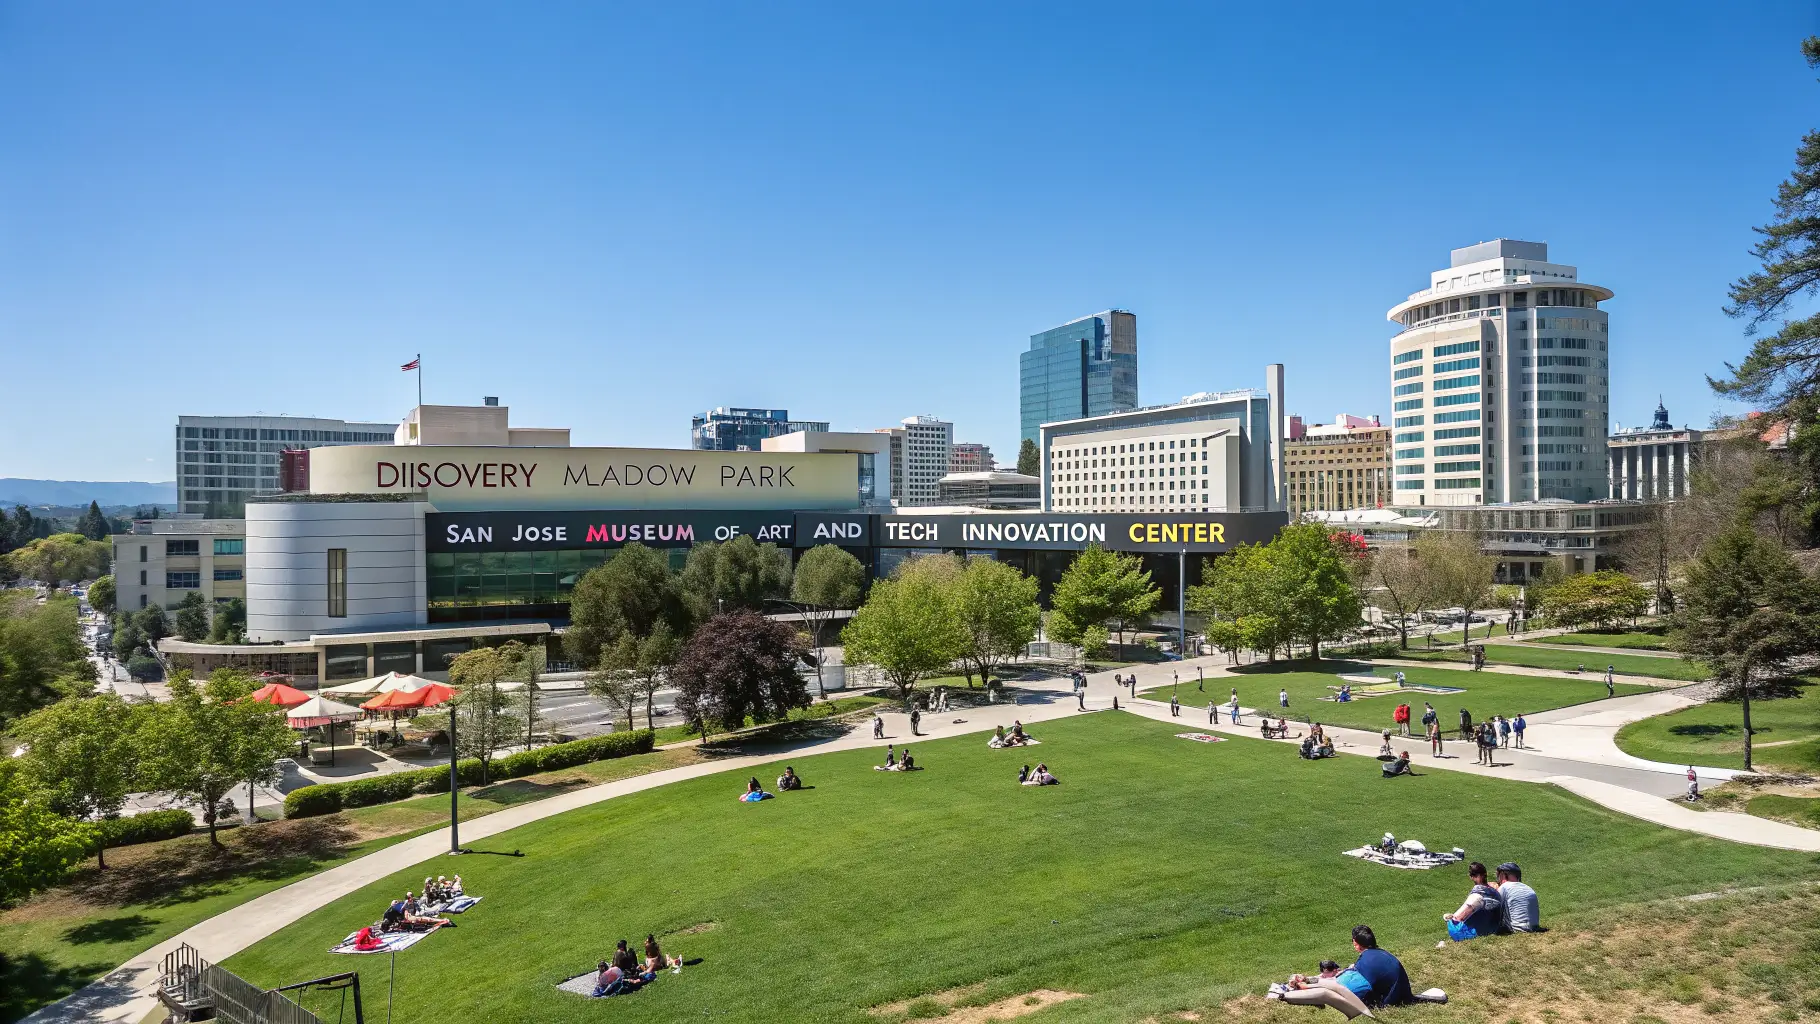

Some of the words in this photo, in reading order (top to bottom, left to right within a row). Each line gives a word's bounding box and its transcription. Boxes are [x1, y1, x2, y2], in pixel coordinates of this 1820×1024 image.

[377, 461, 538, 488] DIISOVERY
[720, 465, 795, 487] PARK
[446, 524, 493, 543] SAN
[512, 525, 567, 542] JOSE
[585, 524, 695, 542] MUSEUM
[714, 526, 740, 541] OF
[756, 525, 792, 540] ART
[813, 523, 862, 539] AND
[885, 522, 938, 541] TECH
[962, 523, 1105, 542] INNOVATION
[1128, 523, 1225, 543] CENTER
